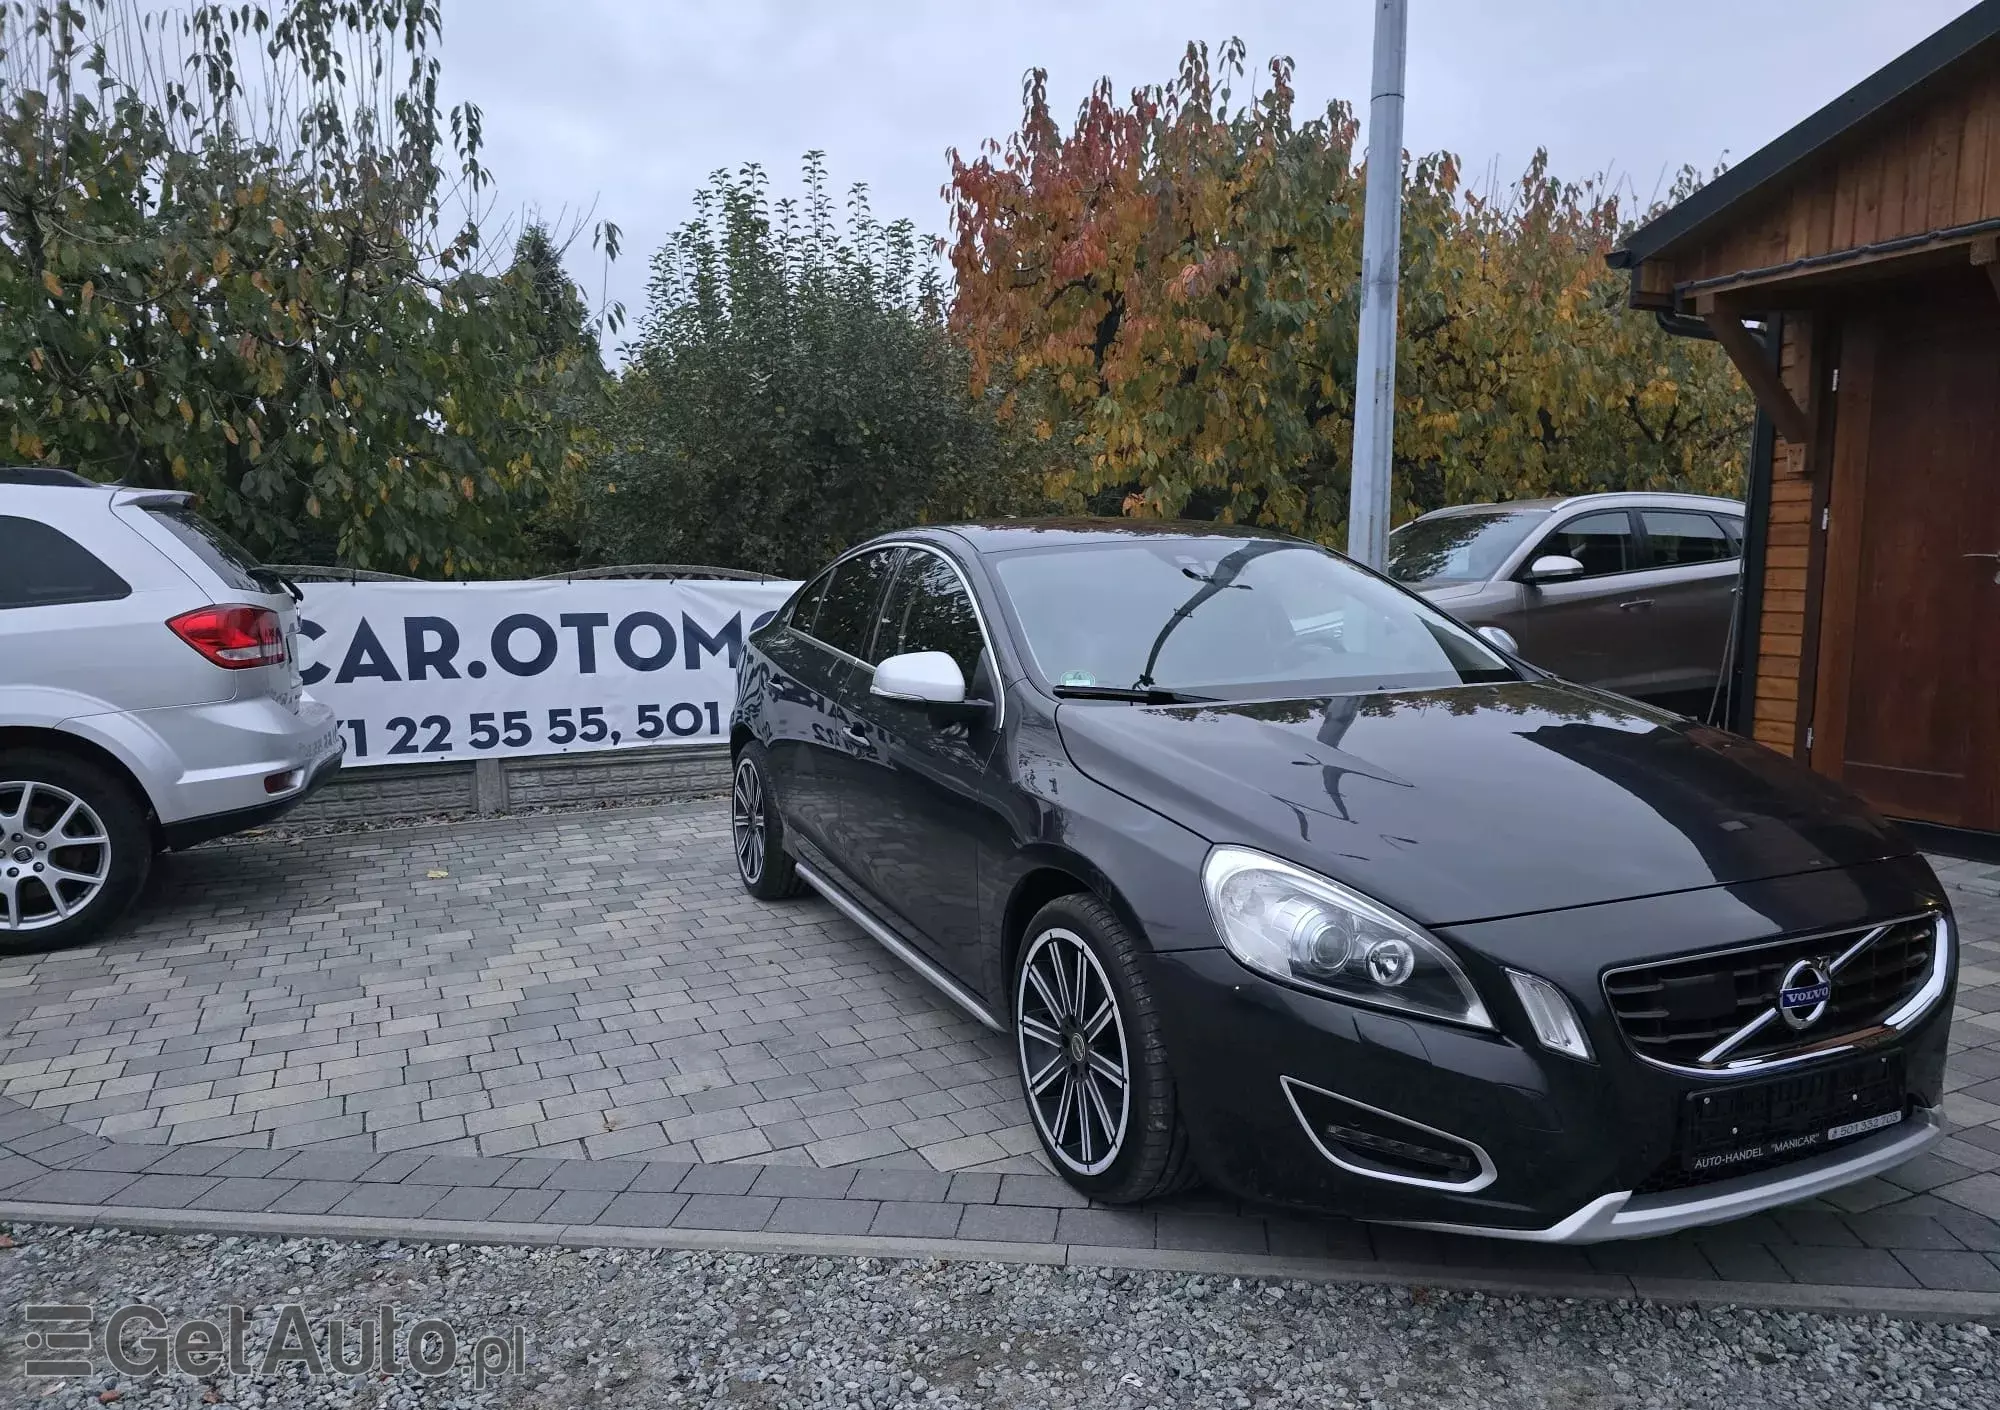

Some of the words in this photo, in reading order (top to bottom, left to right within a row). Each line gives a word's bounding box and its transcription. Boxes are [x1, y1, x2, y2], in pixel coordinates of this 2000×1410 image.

[385, 714, 453, 755] 22
[468, 712, 532, 750] 55
[547, 706, 621, 746] 55,
[636, 701, 720, 739] 501
[1786, 986, 1829, 1003] VOLVO
[1694, 1146, 1764, 1169] AUTO-HANDEL
